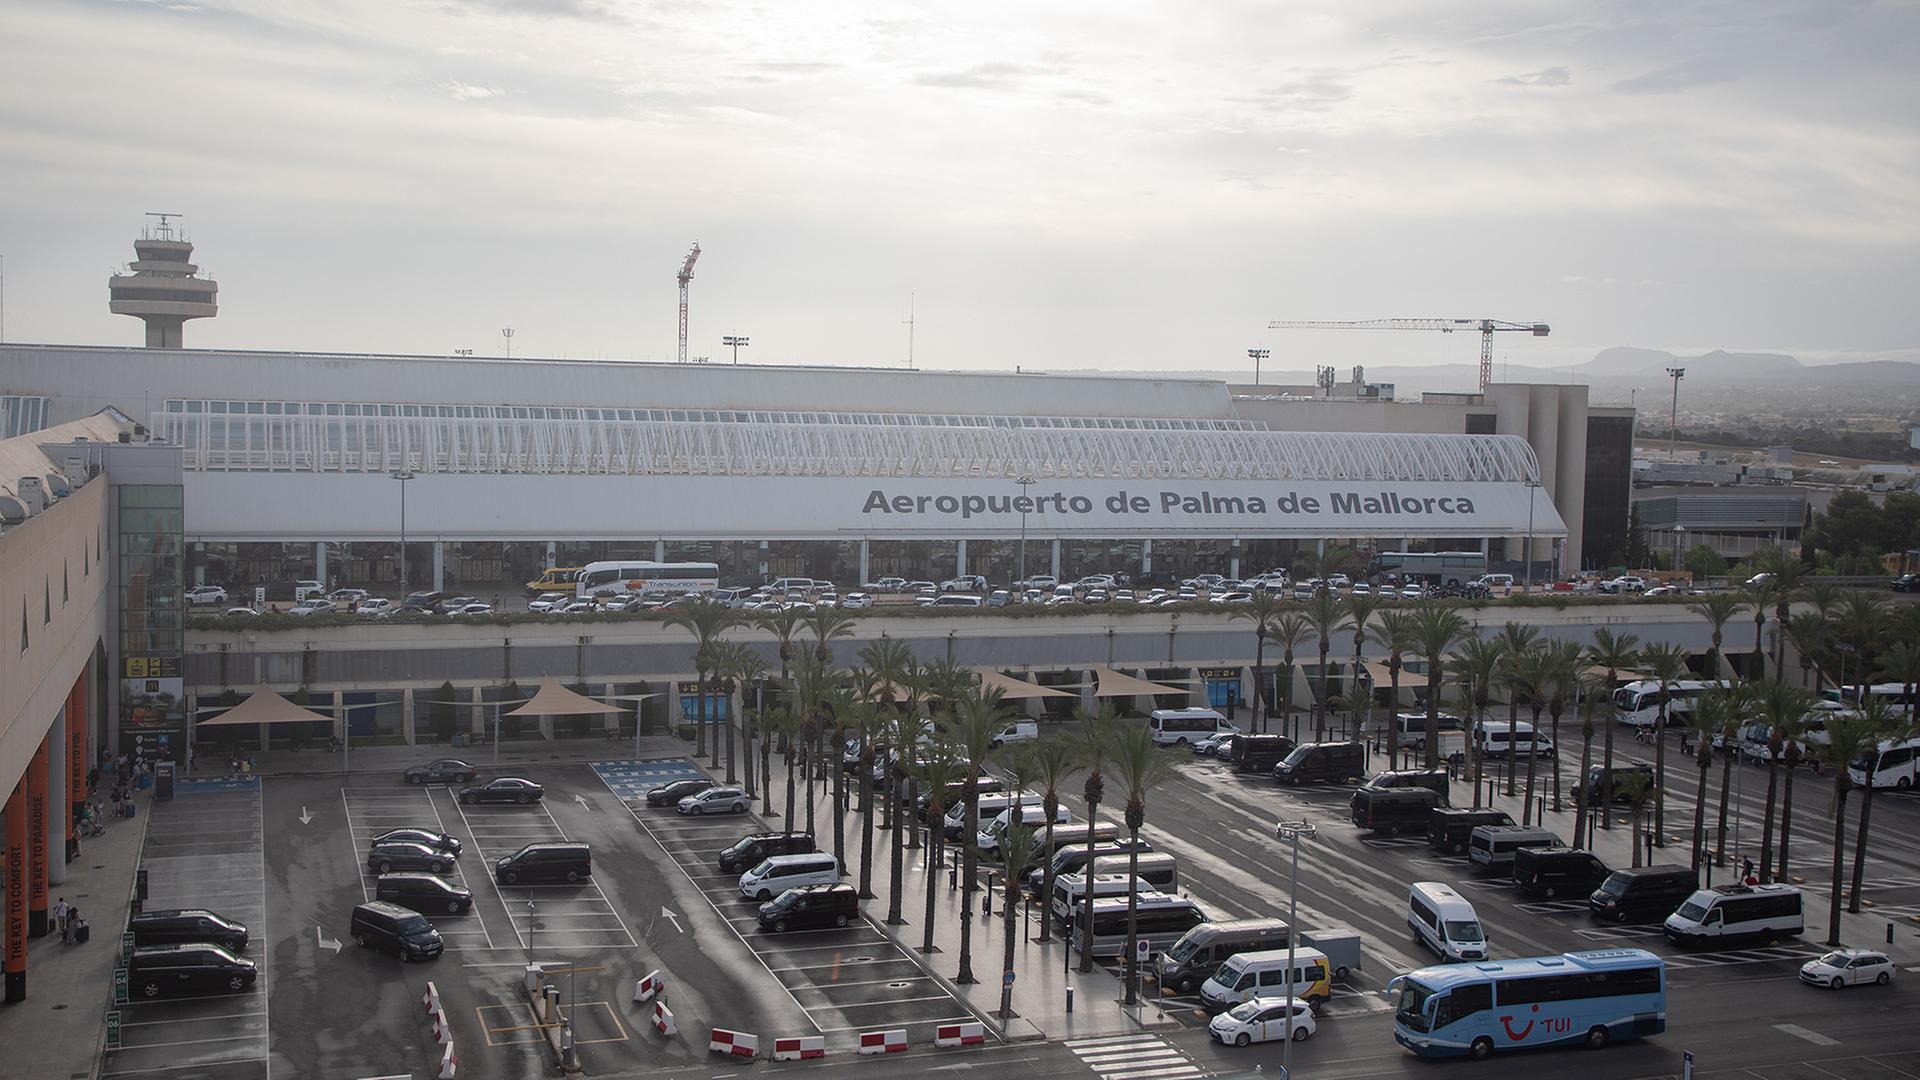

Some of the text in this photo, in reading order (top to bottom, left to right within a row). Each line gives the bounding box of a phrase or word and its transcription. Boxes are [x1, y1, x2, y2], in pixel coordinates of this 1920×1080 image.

[863, 490, 1475, 518] Aeropuerto de Palma de Mallorca
[32, 793, 43, 899] THE KEY TO PARADISE.
[11, 843, 22, 960] THE KEY TO COMFORT.
[108, 1020, 119, 1029] 06
[1544, 1017, 1571, 1033] TUI
